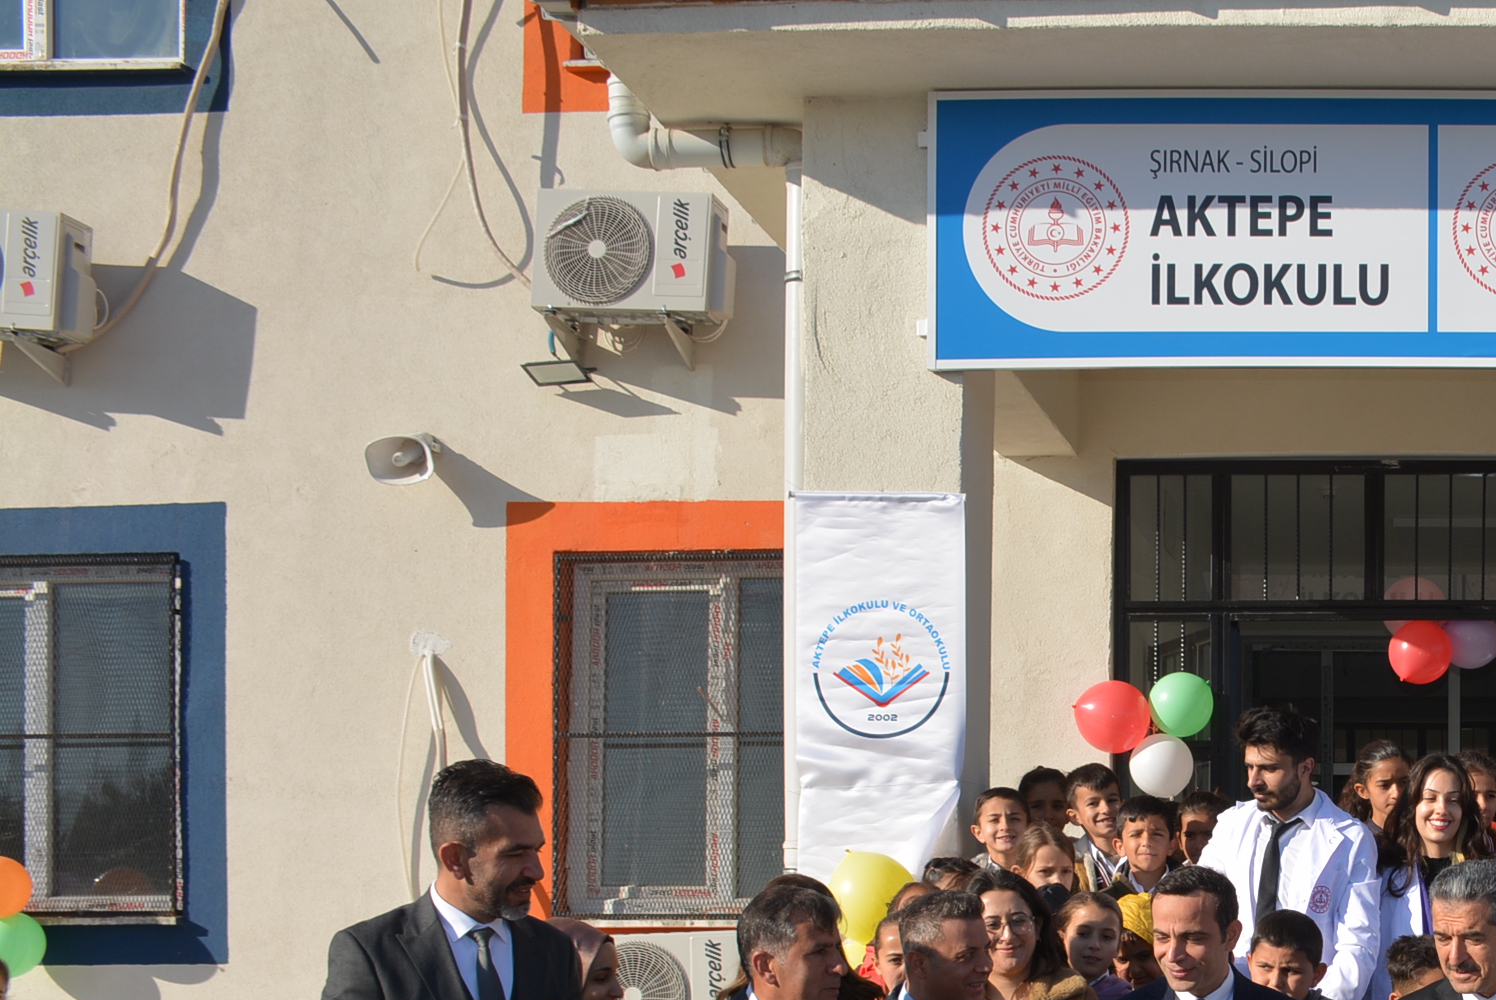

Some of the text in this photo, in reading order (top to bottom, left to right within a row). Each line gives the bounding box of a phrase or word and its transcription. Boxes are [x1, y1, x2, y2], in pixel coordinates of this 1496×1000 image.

[1149, 149, 1230, 180] ŞIRNAK
[1249, 145, 1318, 174] SİLOPİ
[671, 199, 690, 260] arçelik
[1009, 181, 1050, 239] CUMHURİYETİ
[1081, 191, 1103, 225] EĞİTİM
[1149, 194, 1334, 238] AKTEPE
[21, 217, 39, 279] arçelik
[1011, 240, 1046, 273] TÜRKİYE
[1066, 228, 1103, 272] BAKANLIĞI
[1150, 255, 1391, 308] İLKOKULU
[811, 598, 952, 671] AKTEPE İLKOKULU VE ORTAOKULU
[866, 712, 899, 723] 2002
